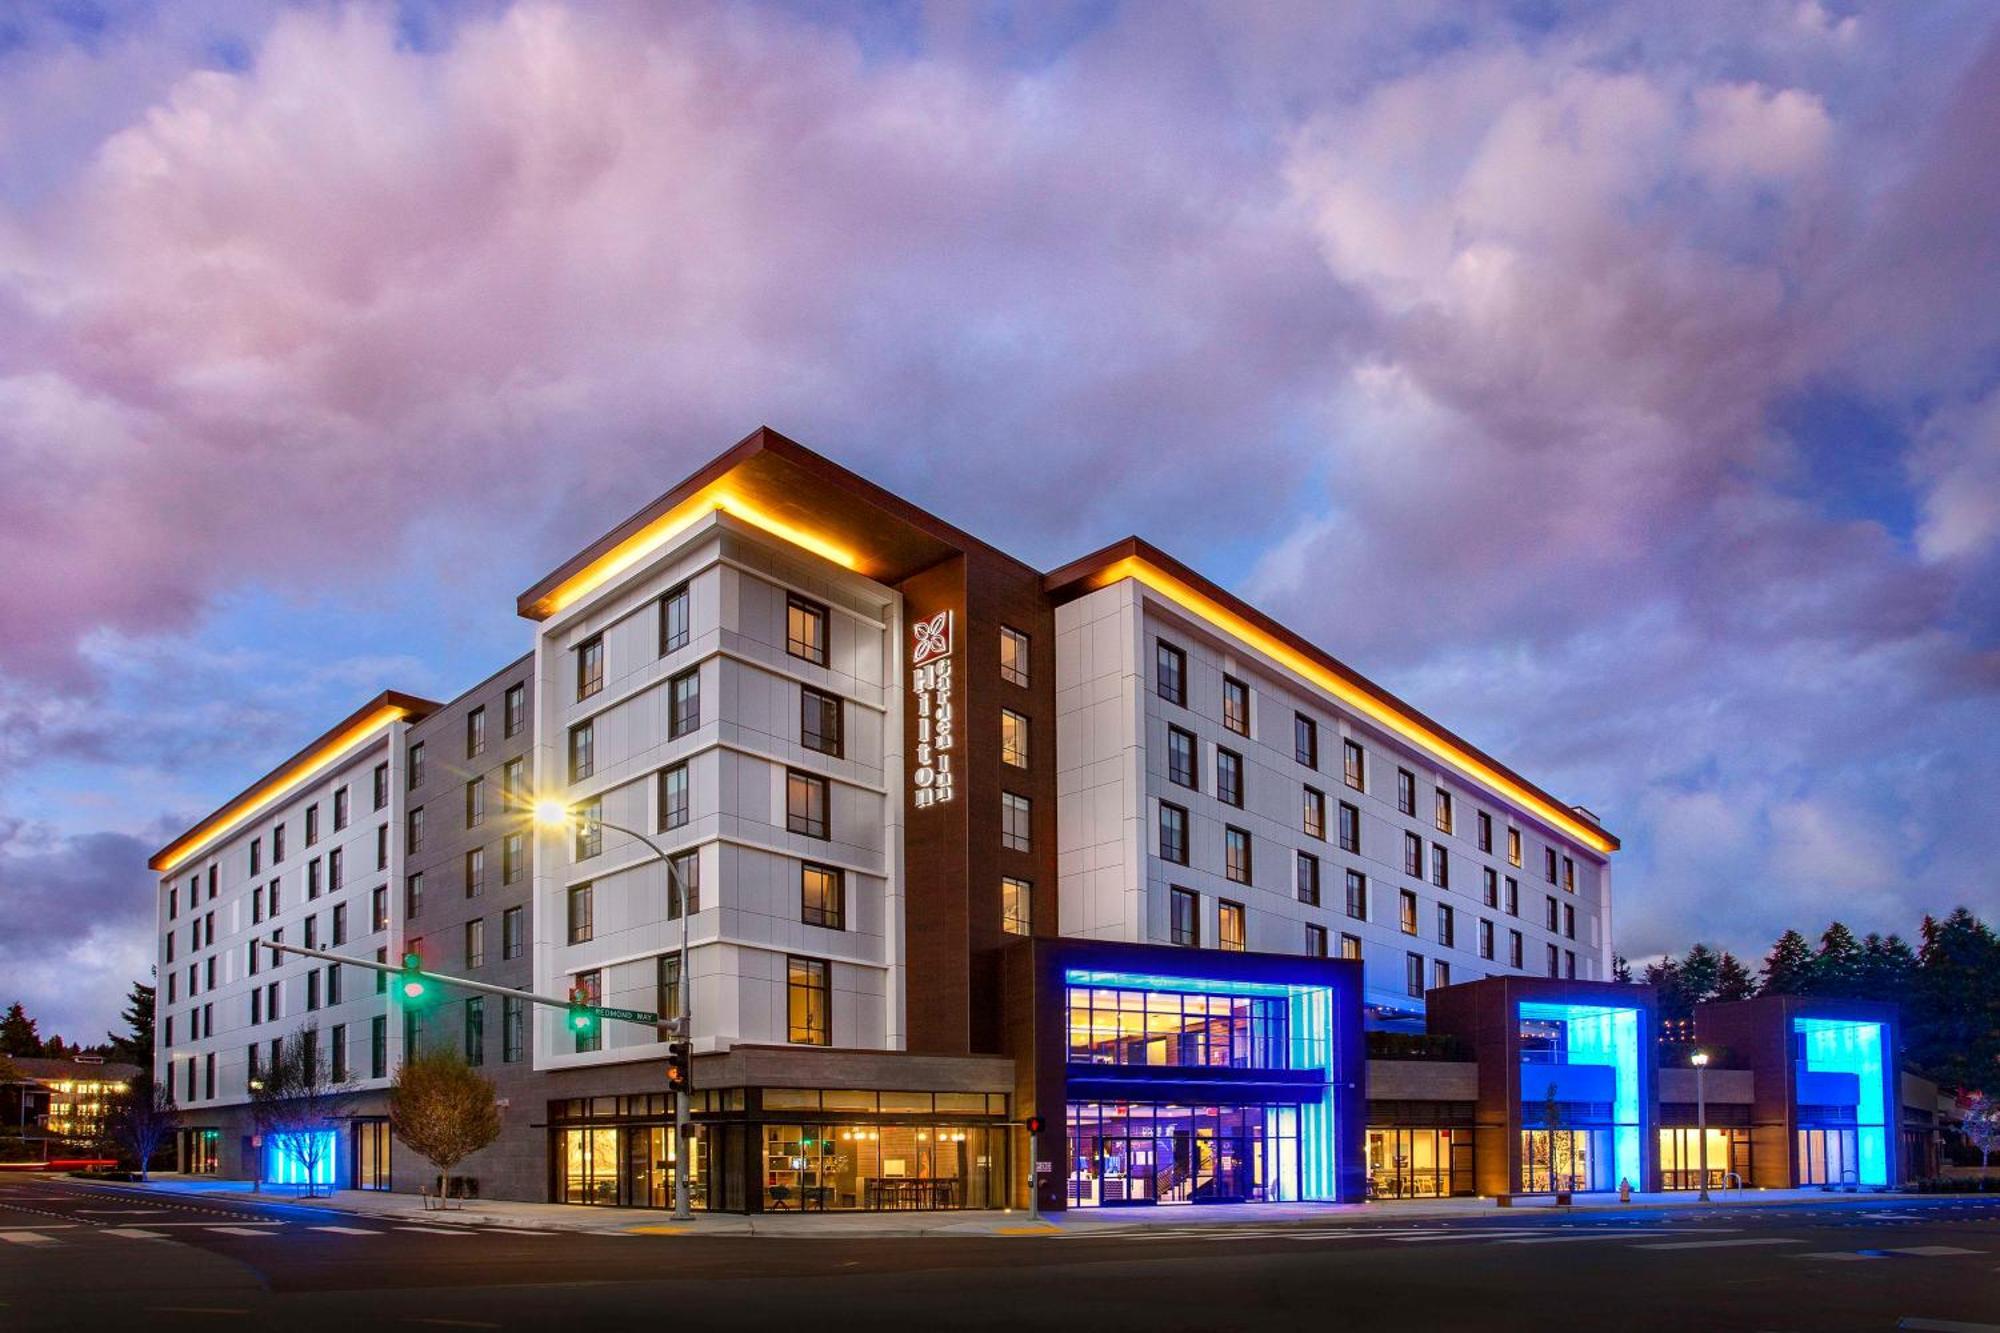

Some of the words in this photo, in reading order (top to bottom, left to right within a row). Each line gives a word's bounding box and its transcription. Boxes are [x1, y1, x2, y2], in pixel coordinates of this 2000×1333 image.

[913, 664, 935, 809] Hilton
[935, 659, 952, 750] Garden
[935, 755, 952, 801] Inn
[596, 1008, 633, 1019] REDMOND
[637, 1013, 652, 1021] WAY
